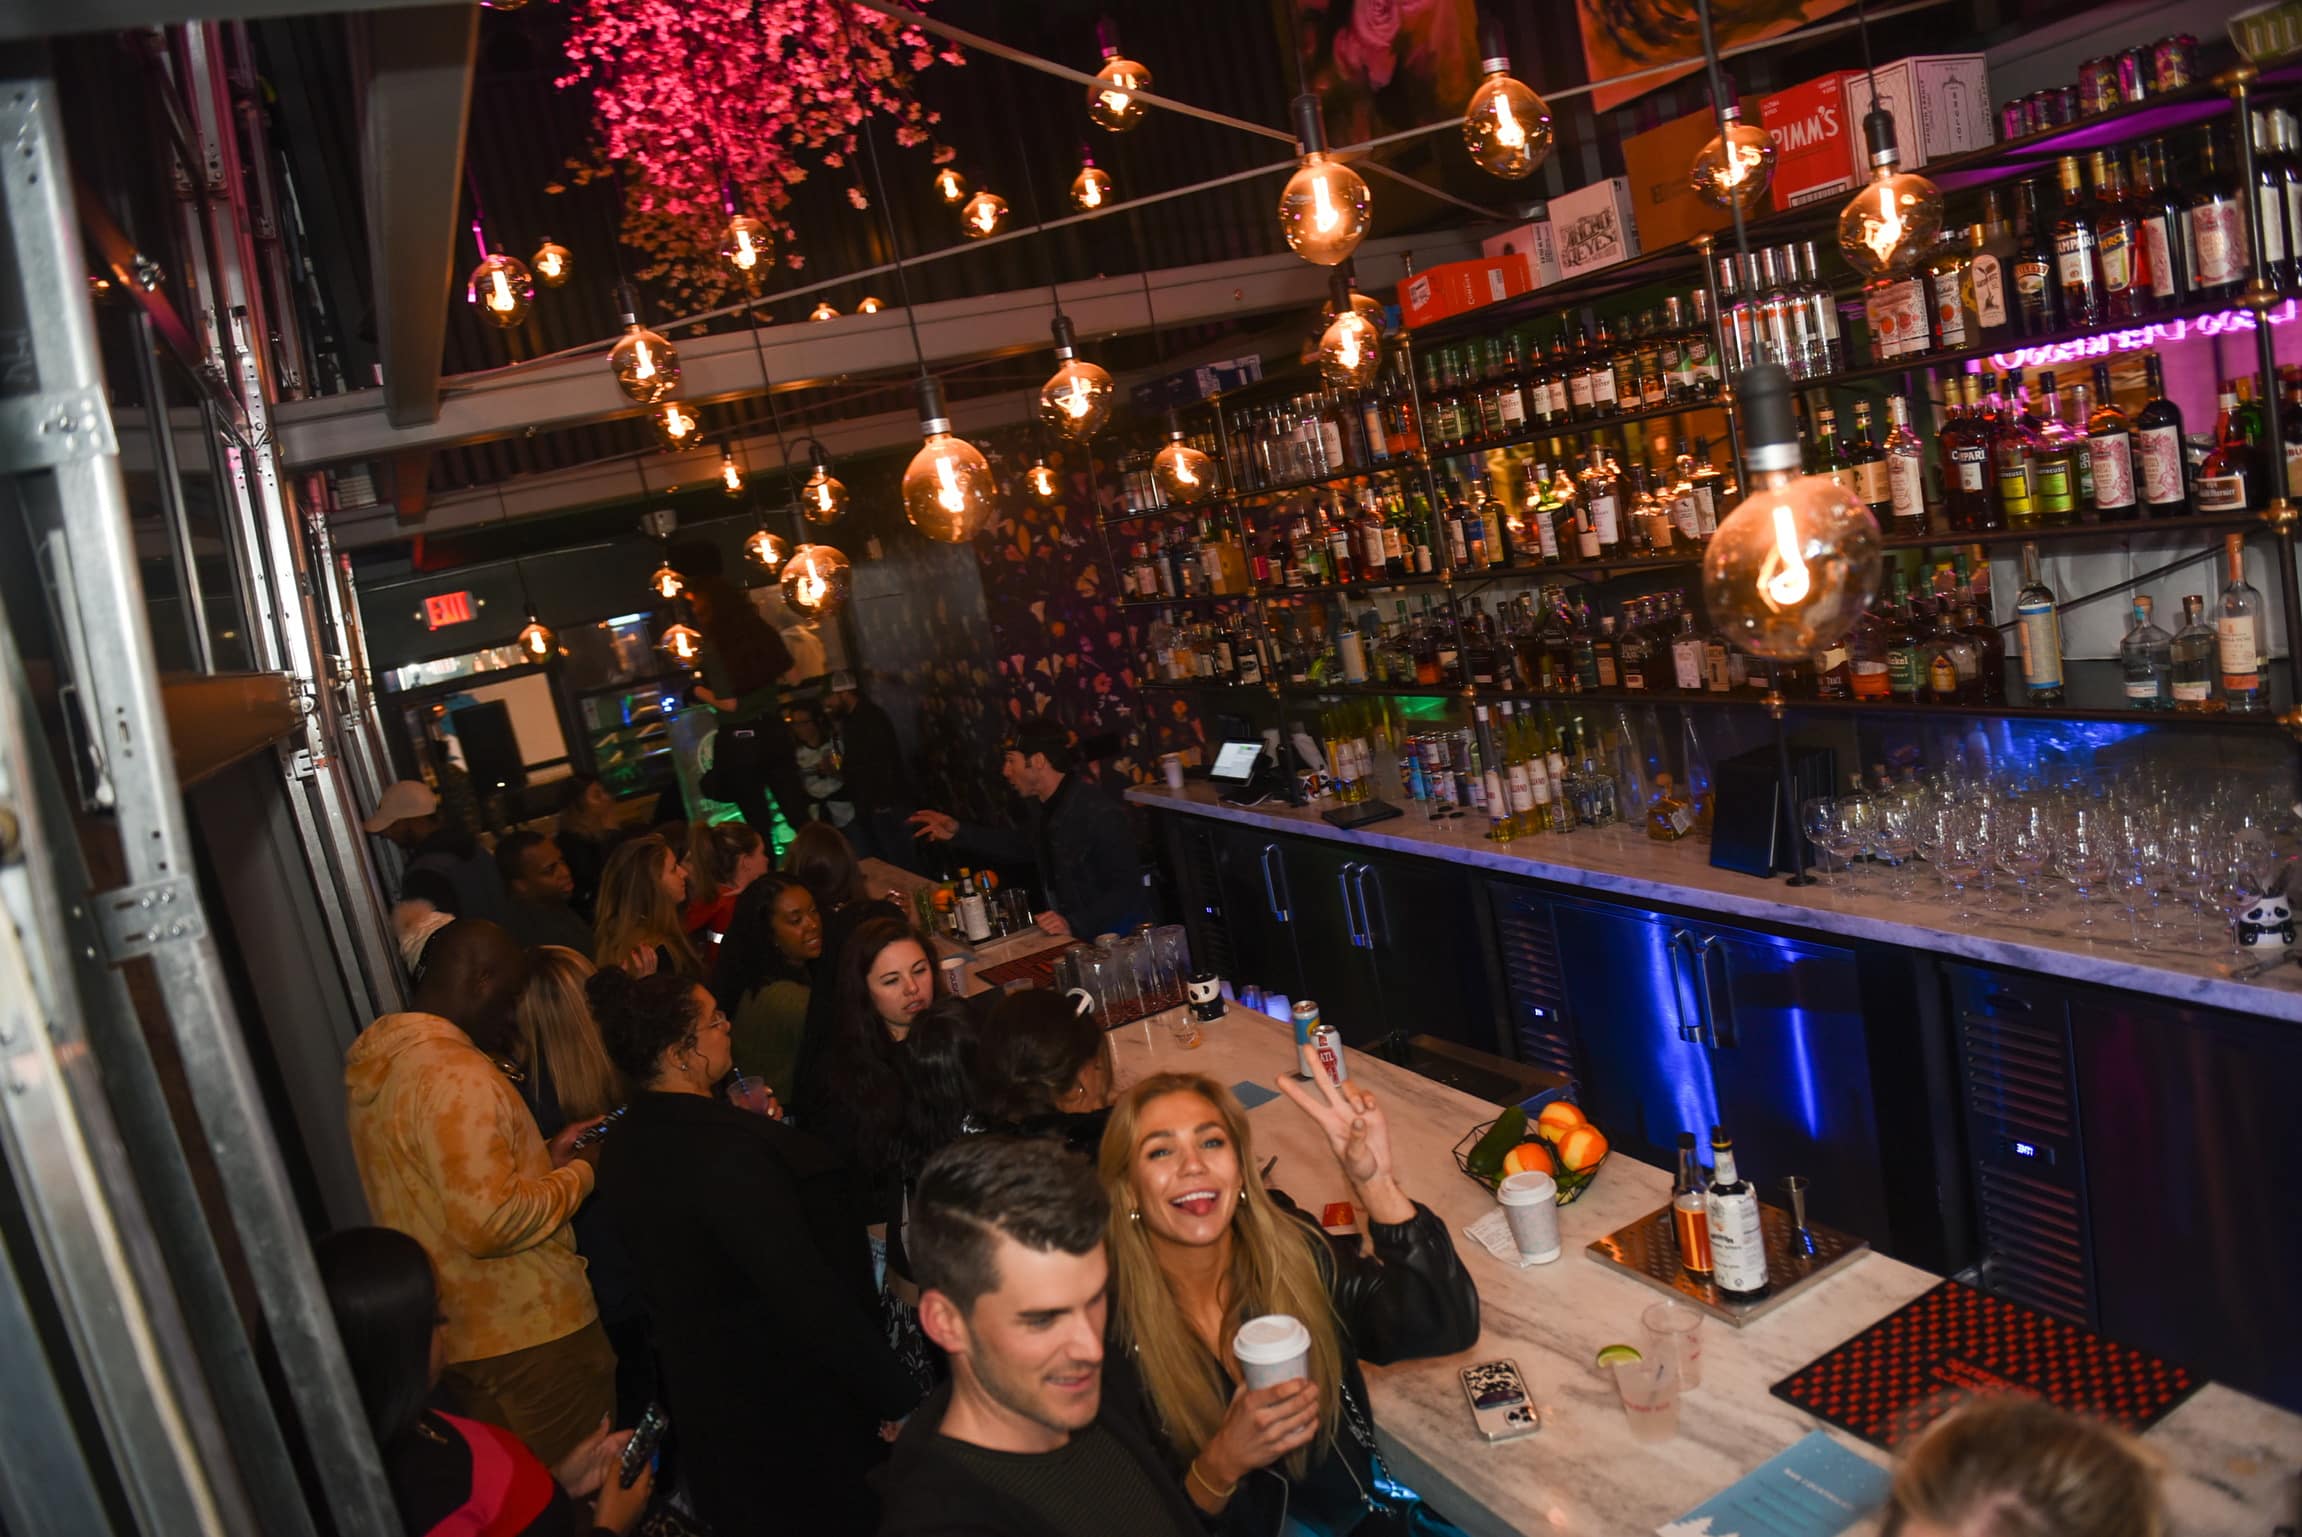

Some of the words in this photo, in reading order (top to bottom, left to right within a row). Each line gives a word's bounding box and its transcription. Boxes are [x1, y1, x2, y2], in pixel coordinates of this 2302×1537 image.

[1769, 105, 1839, 152] PIMM'S
[1951, 449, 1985, 461] CMPARI
[427, 594, 470, 624] EXIT
